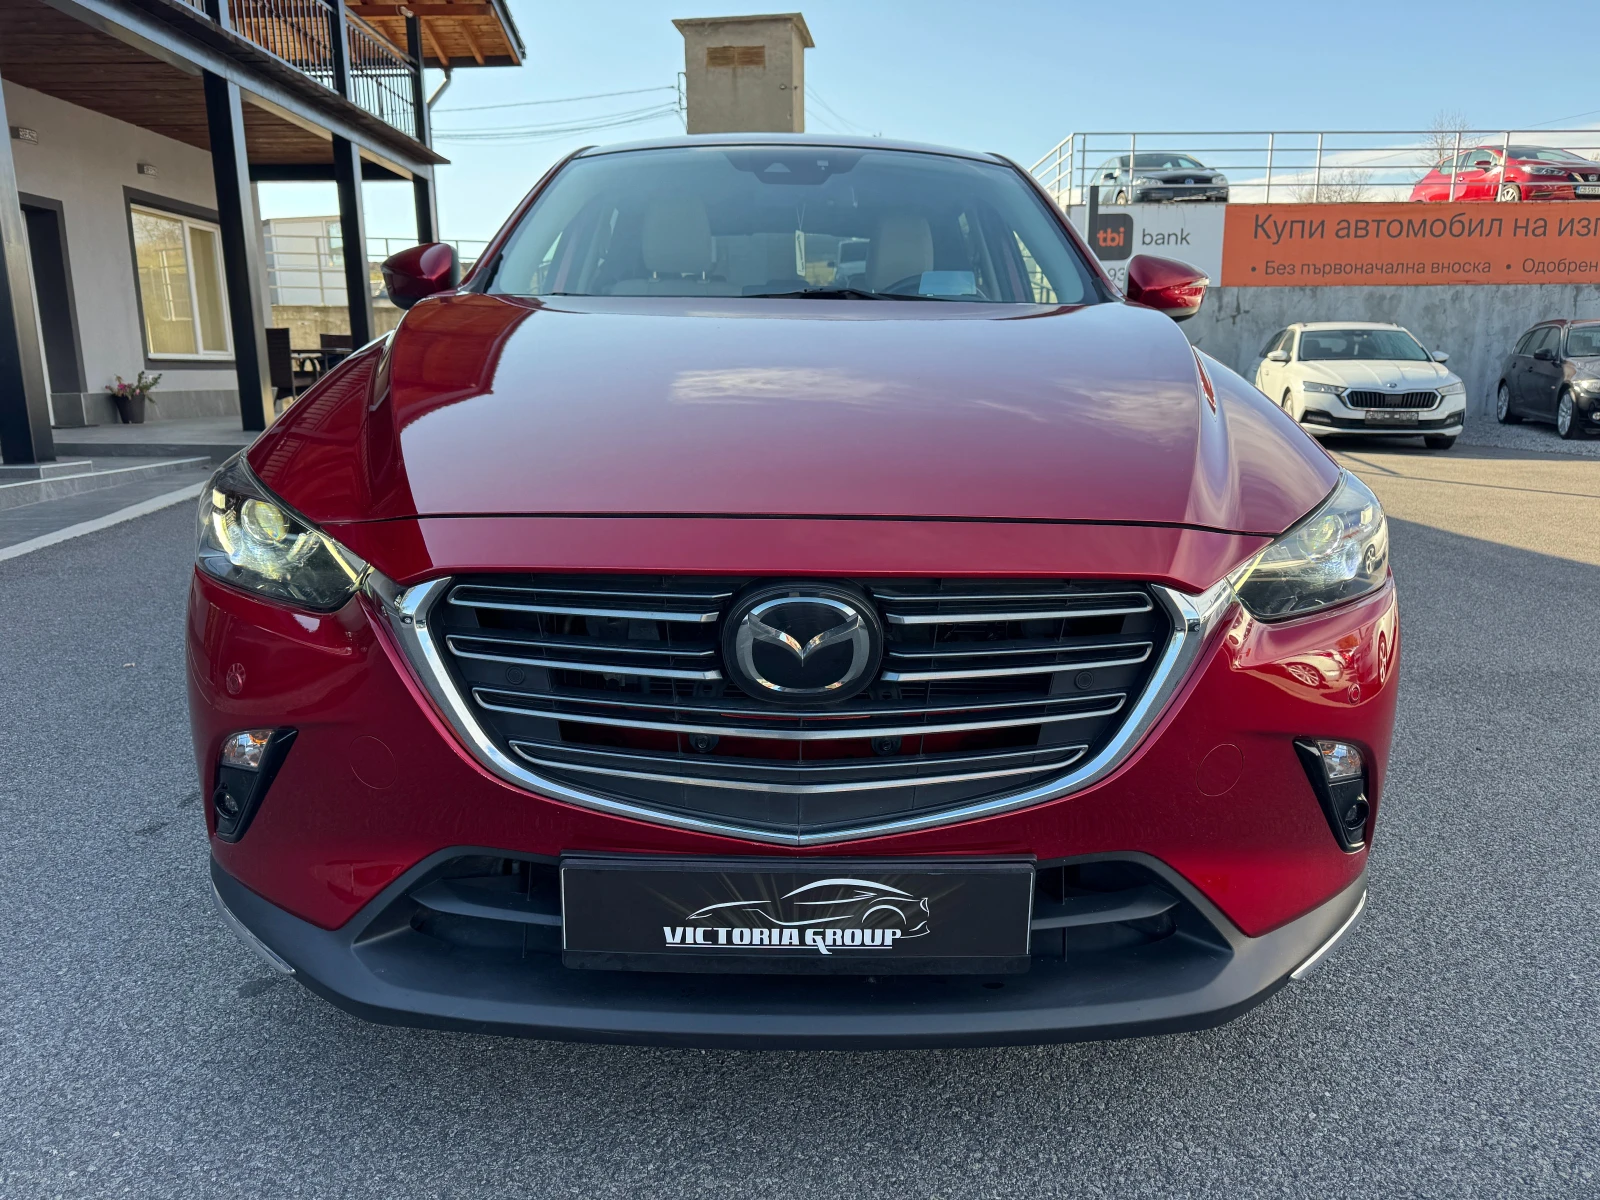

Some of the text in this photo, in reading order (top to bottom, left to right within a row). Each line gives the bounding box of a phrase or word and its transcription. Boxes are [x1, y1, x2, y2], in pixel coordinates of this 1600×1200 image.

[1097, 227, 1191, 247] tbi bank
[1253, 214, 1326, 245] Купи
[1335, 212, 1503, 239] автомобил
[1513, 216, 1548, 238] на
[1264, 260, 1492, 278] Без първоначална вноска
[1522, 258, 1599, 276] Одобрен
[663, 926, 901, 954] VICTORIA GROUP
